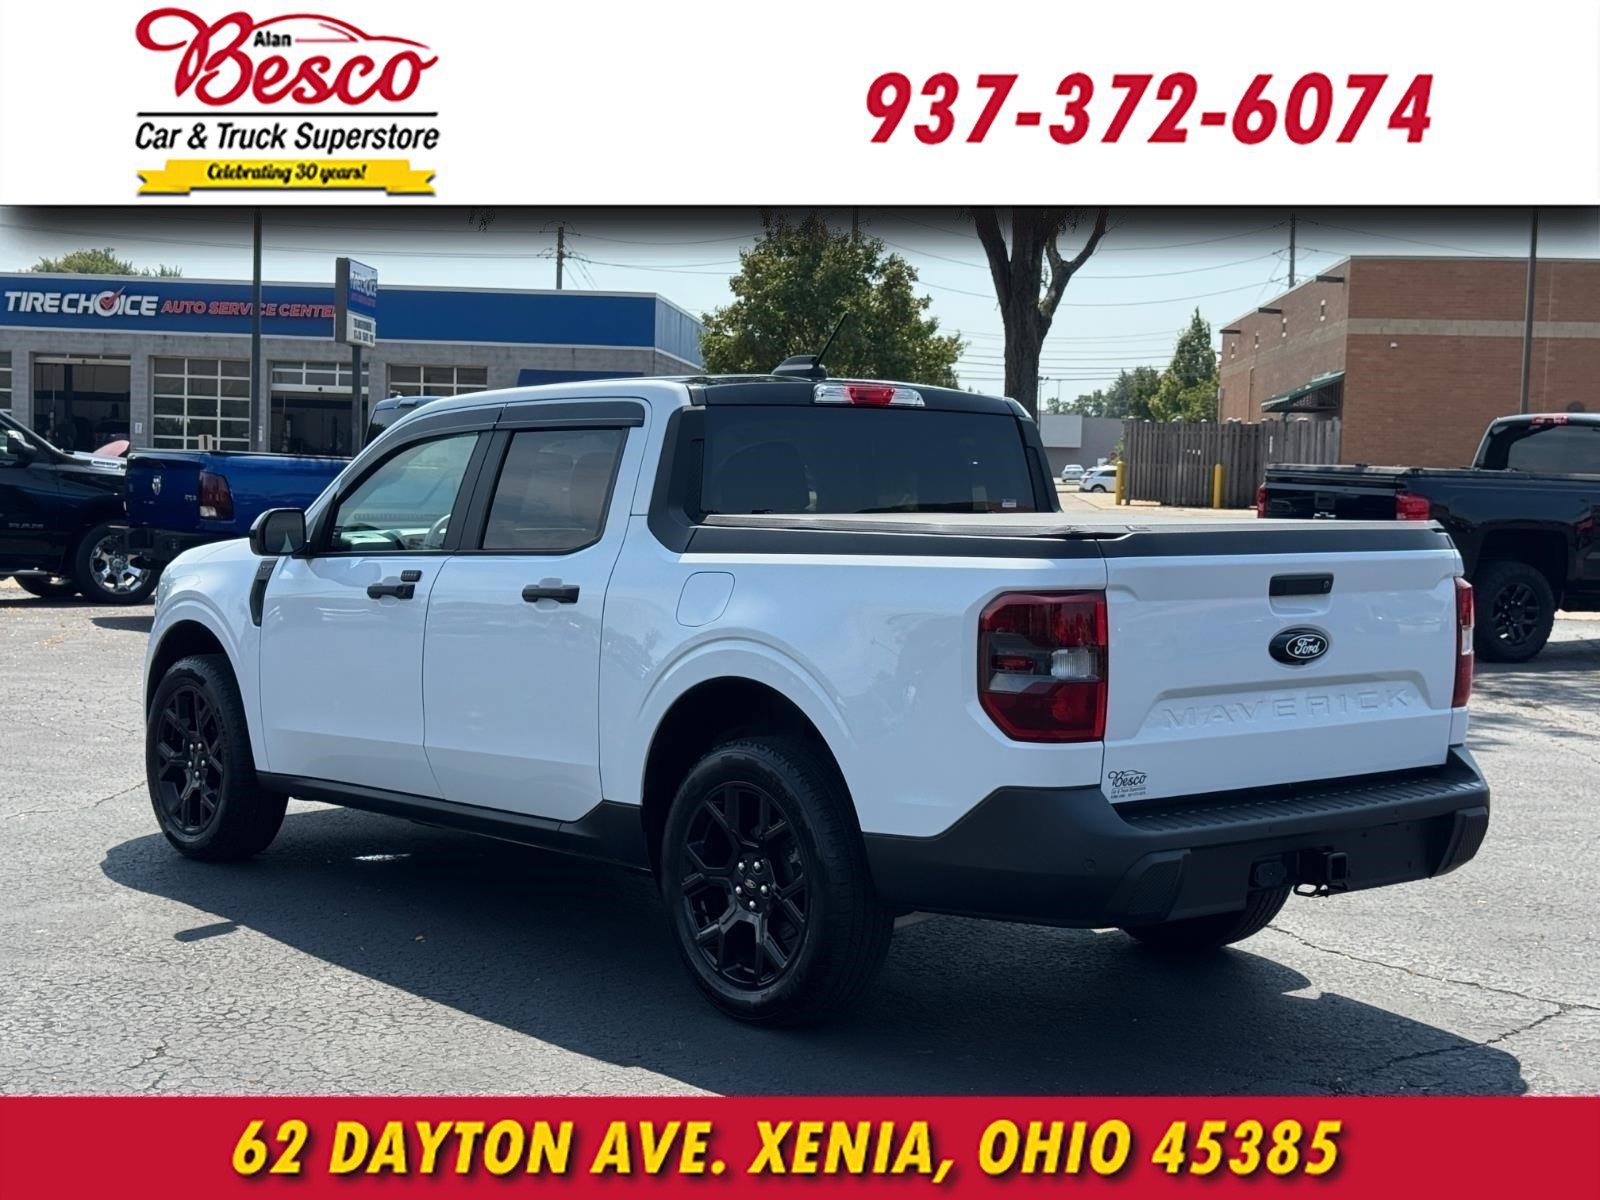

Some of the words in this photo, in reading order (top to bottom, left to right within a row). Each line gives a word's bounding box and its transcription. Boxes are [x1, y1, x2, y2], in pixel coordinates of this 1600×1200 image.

[161, 300, 207, 314] AUTO
[1294, 638, 1322, 655] Ford
[1161, 688, 1410, 730] MAVERICK
[1108, 770, 1148, 788] Besco
